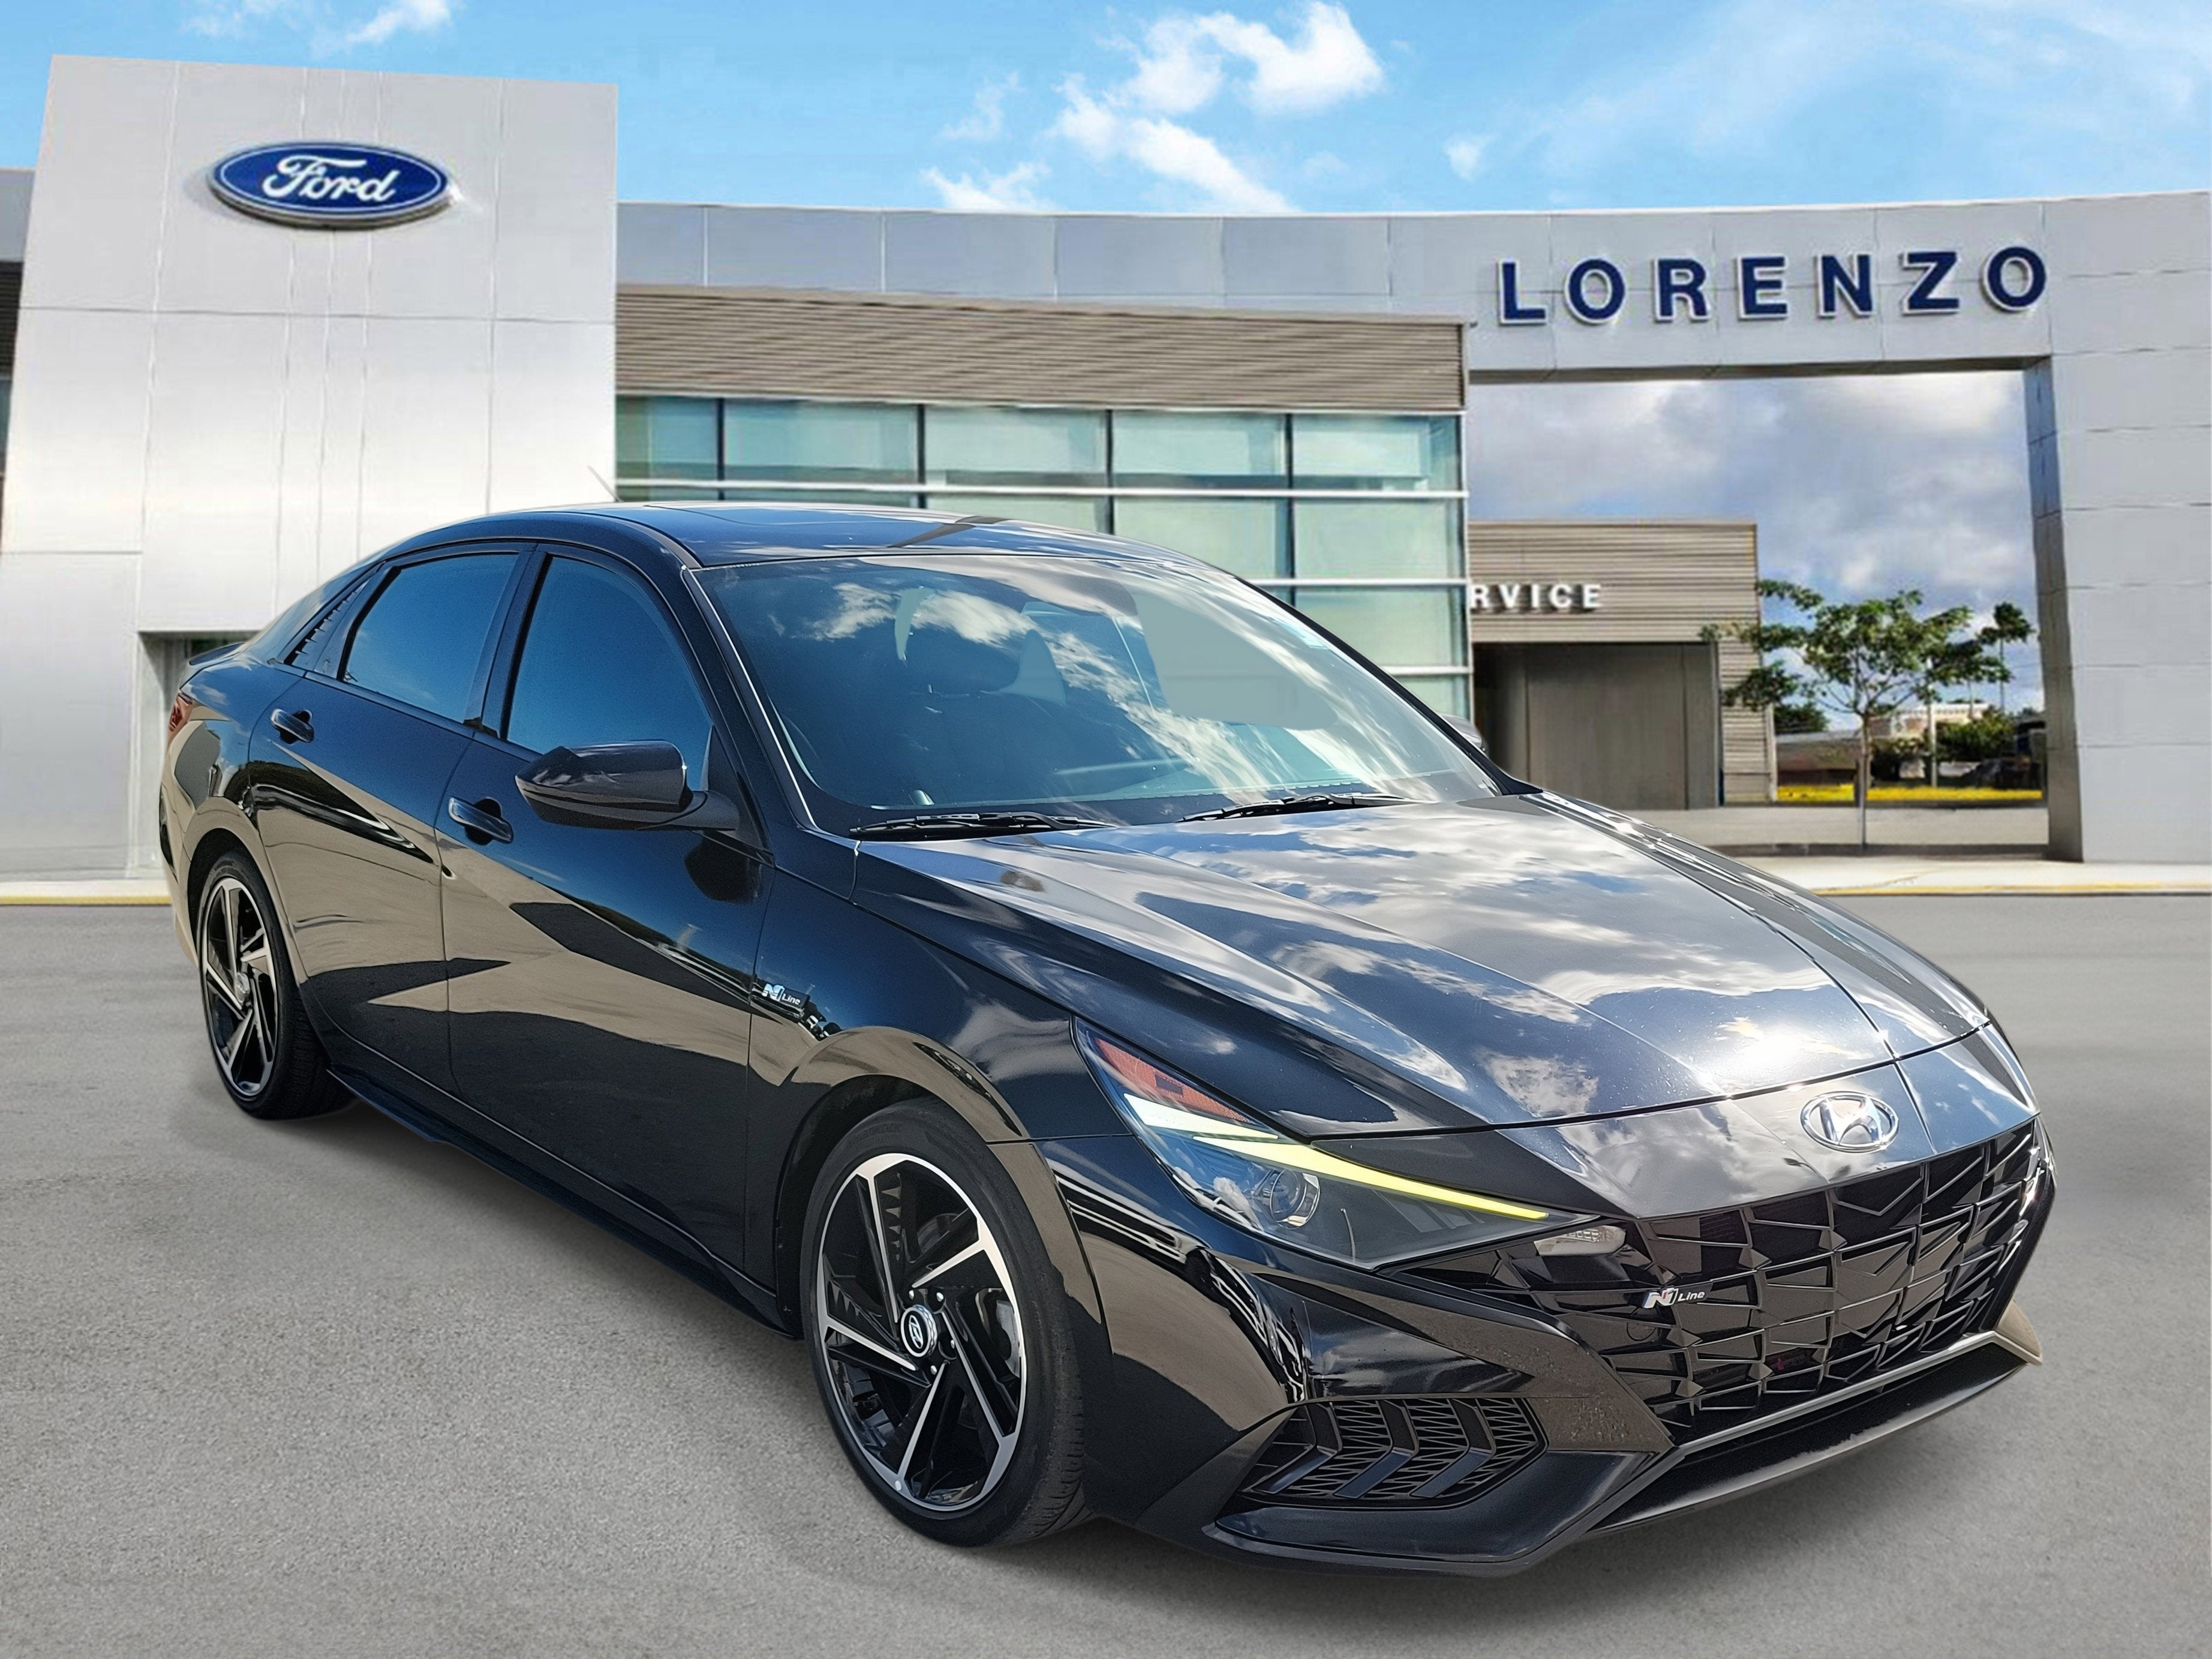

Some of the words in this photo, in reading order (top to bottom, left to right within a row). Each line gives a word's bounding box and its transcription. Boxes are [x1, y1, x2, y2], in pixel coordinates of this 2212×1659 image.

[262, 154, 401, 202] Ford
[1497, 246, 2048, 324] LORENZO
[782, 993, 801, 1005] Line
[1678, 1291, 1705, 1302] Line
